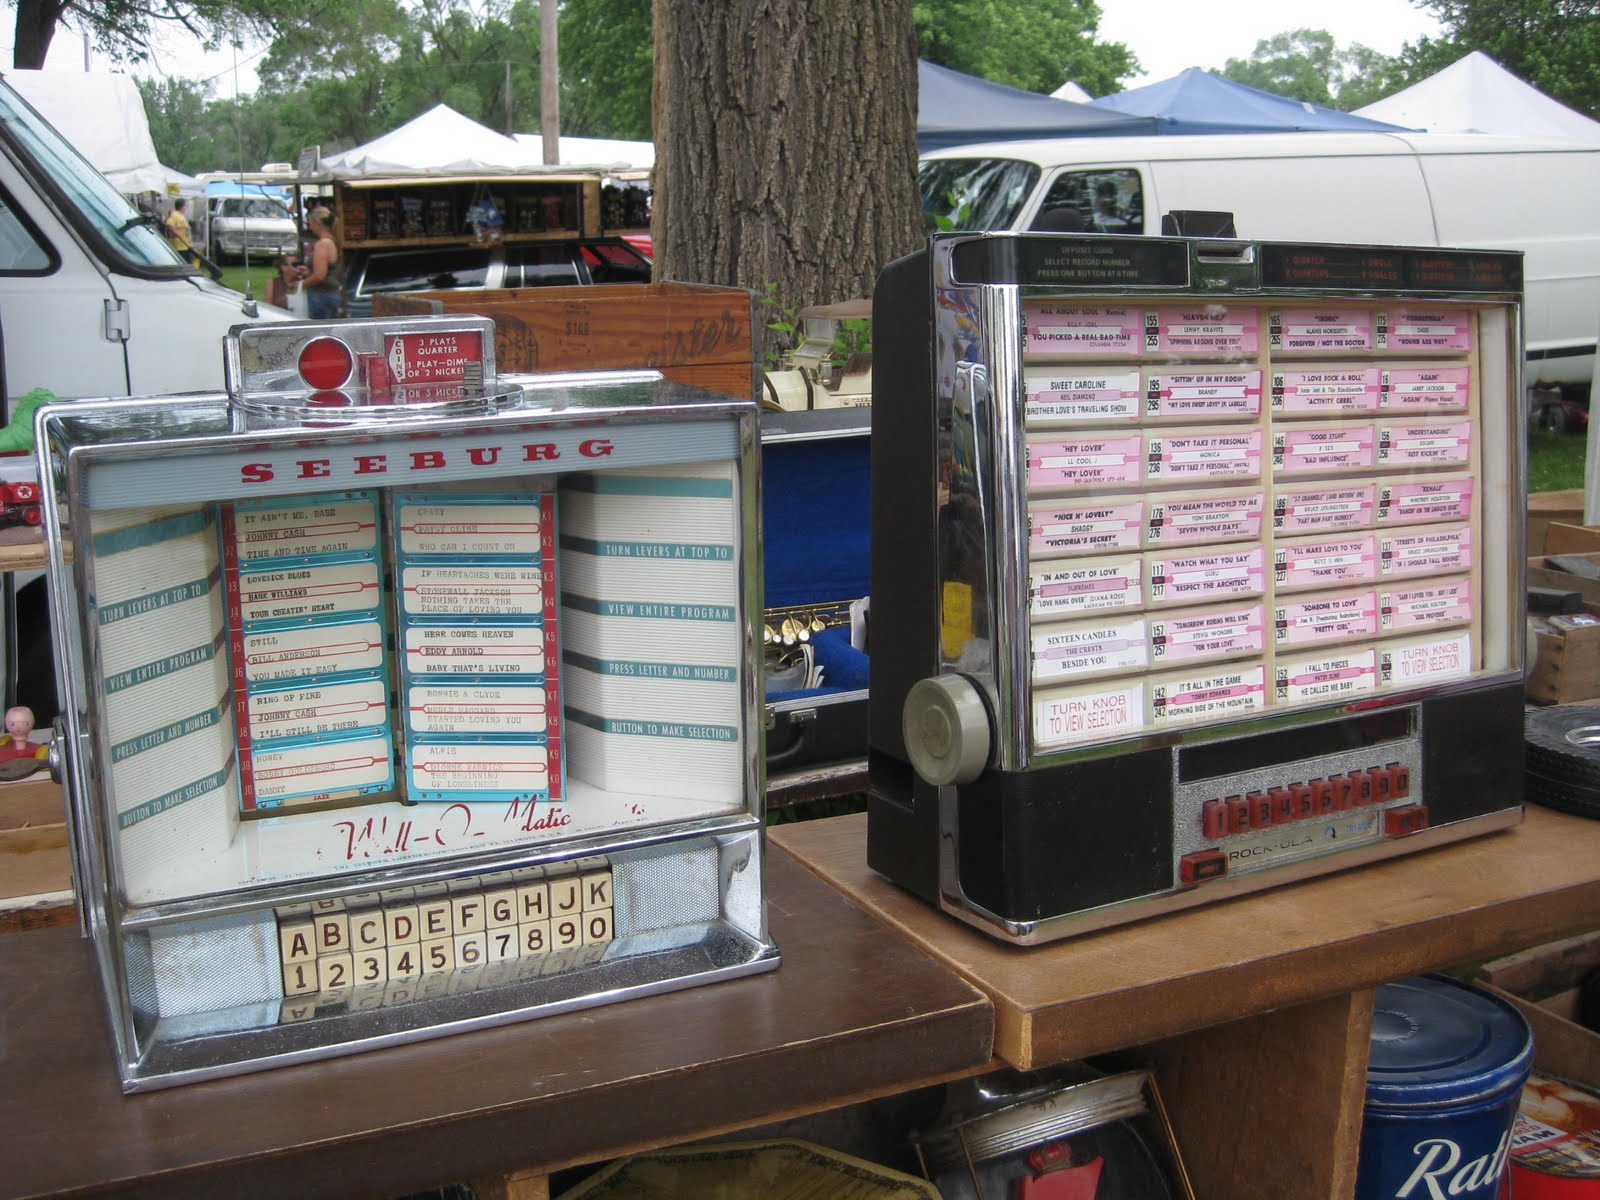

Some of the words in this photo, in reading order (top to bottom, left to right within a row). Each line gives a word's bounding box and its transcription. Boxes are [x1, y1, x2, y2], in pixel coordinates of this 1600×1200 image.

[418, 346, 457, 355] QUARTER
[1050, 381, 1072, 390] SWEET
[1075, 381, 1106, 389] CAROLINE
[1027, 407, 1054, 415] BROTHER
[1056, 406, 1076, 414] LOVE'S
[1078, 405, 1108, 413] TRAVELING
[240, 439, 614, 484] SEEBURG
[244, 515, 256, 523] IT
[261, 513, 288, 522] AIN'T
[314, 509, 336, 518] BABE
[245, 531, 279, 541] JOHNNY
[283, 529, 305, 537] CASH
[606, 545, 630, 556] TURN
[636, 546, 670, 557] LEVERS
[675, 547, 686, 557] AT
[692, 547, 709, 558] TOP
[715, 548, 727, 558] TO
[1152, 565, 1164, 575] 117
[247, 574, 284, 584] LOVESICK
[288, 572, 311, 580] BLUES
[1153, 585, 1164, 596] 217
[104, 607, 124, 622] TURN
[128, 596, 156, 615] LEVERS
[160, 593, 168, 606] AT
[173, 588, 187, 602] TOP
[191, 584, 200, 596] TO
[273, 607, 308, 616] CHEATIN'
[609, 605, 634, 615] VIEW
[640, 606, 675, 617] ENTIRE
[681, 608, 729, 619] PROGRAM
[251, 637, 278, 647] STILL
[1048, 635, 1080, 645] SIXTEEN
[1082, 630, 1117, 641] CANDLES
[1079, 645, 1102, 653] CRESTS
[1402, 648, 1428, 659] TURN
[1433, 643, 1458, 654] KNOB
[252, 654, 274, 664] BILL
[279, 649, 321, 660] ANDERSON
[111, 672, 132, 690] VIEW
[136, 662, 166, 677] ENTIRE
[170, 648, 206, 669] PROGRAM
[452, 664, 484, 672] THAT'S
[1062, 659, 1088, 669] BESIDE
[1090, 657, 1107, 665] YOU
[1309, 664, 1321, 672] FALL
[1331, 660, 1348, 669] PIECES
[253, 672, 270, 681] YOU
[274, 670, 296, 678] MADE
[301, 667, 312, 675] IT
[317, 664, 337, 673] EASY
[609, 664, 634, 674] PRESS
[639, 665, 667, 676] LETTER
[672, 667, 690, 677] AND
[694, 668, 729, 679] NUMBER
[1277, 670, 1287, 679] 152
[1179, 683, 1190, 692] IT'S
[1205, 680, 1210, 688] IN
[1213, 678, 1224, 686] THE
[1226, 676, 1241, 685] GAME
[1301, 688, 1308, 696] HE
[1310, 685, 1329, 694] CALLED
[1340, 681, 1353, 689] BABY
[257, 696, 279, 705] RING
[300, 692, 321, 700] FIRE
[1155, 688, 1164, 698] 142
[1277, 688, 1287, 698] 252
[1051, 701, 1087, 715] TURN
[1093, 695, 1126, 709] KNOB
[1168, 706, 1193, 716] MORNING
[1195, 704, 1206, 712] SIDE
[1208, 702, 1215, 711] OF
[1216, 700, 1225, 708] THE
[1227, 697, 1253, 707] MOUNTAIN
[258, 712, 291, 721] JOHNNY
[295, 709, 316, 718] CASH
[1155, 707, 1165, 717] 242
[1050, 717, 1061, 734] TO
[1065, 715, 1085, 731] VIEW
[1087, 708, 1127, 728] SELECTION
[612, 722, 643, 734] BUTTON
[648, 725, 658, 734] TO
[662, 726, 684, 736] MAKE
[689, 729, 730, 739] SELECTION
[256, 753, 283, 762] HONEY
[259, 786, 285, 795] DANNY
[291, 933, 309, 958] A
[324, 922, 341, 946] B
[361, 921, 377, 943] C
[395, 916, 412, 939] D
[428, 909, 446, 933] E
[462, 903, 478, 927] F
[494, 899, 510, 922] G
[525, 892, 542, 916] H
[559, 887, 575, 910] J
[591, 880, 607, 904] K
[296, 965, 306, 988] 1
[329, 964, 346, 987] 2
[364, 957, 379, 980] 3
[397, 951, 413, 974] 4
[431, 945, 446, 968] 5
[462, 941, 480, 963] 6
[495, 934, 511, 957] 7
[528, 928, 543, 950] 8
[558, 922, 575, 944] 9
[590, 917, 606, 938] 0
